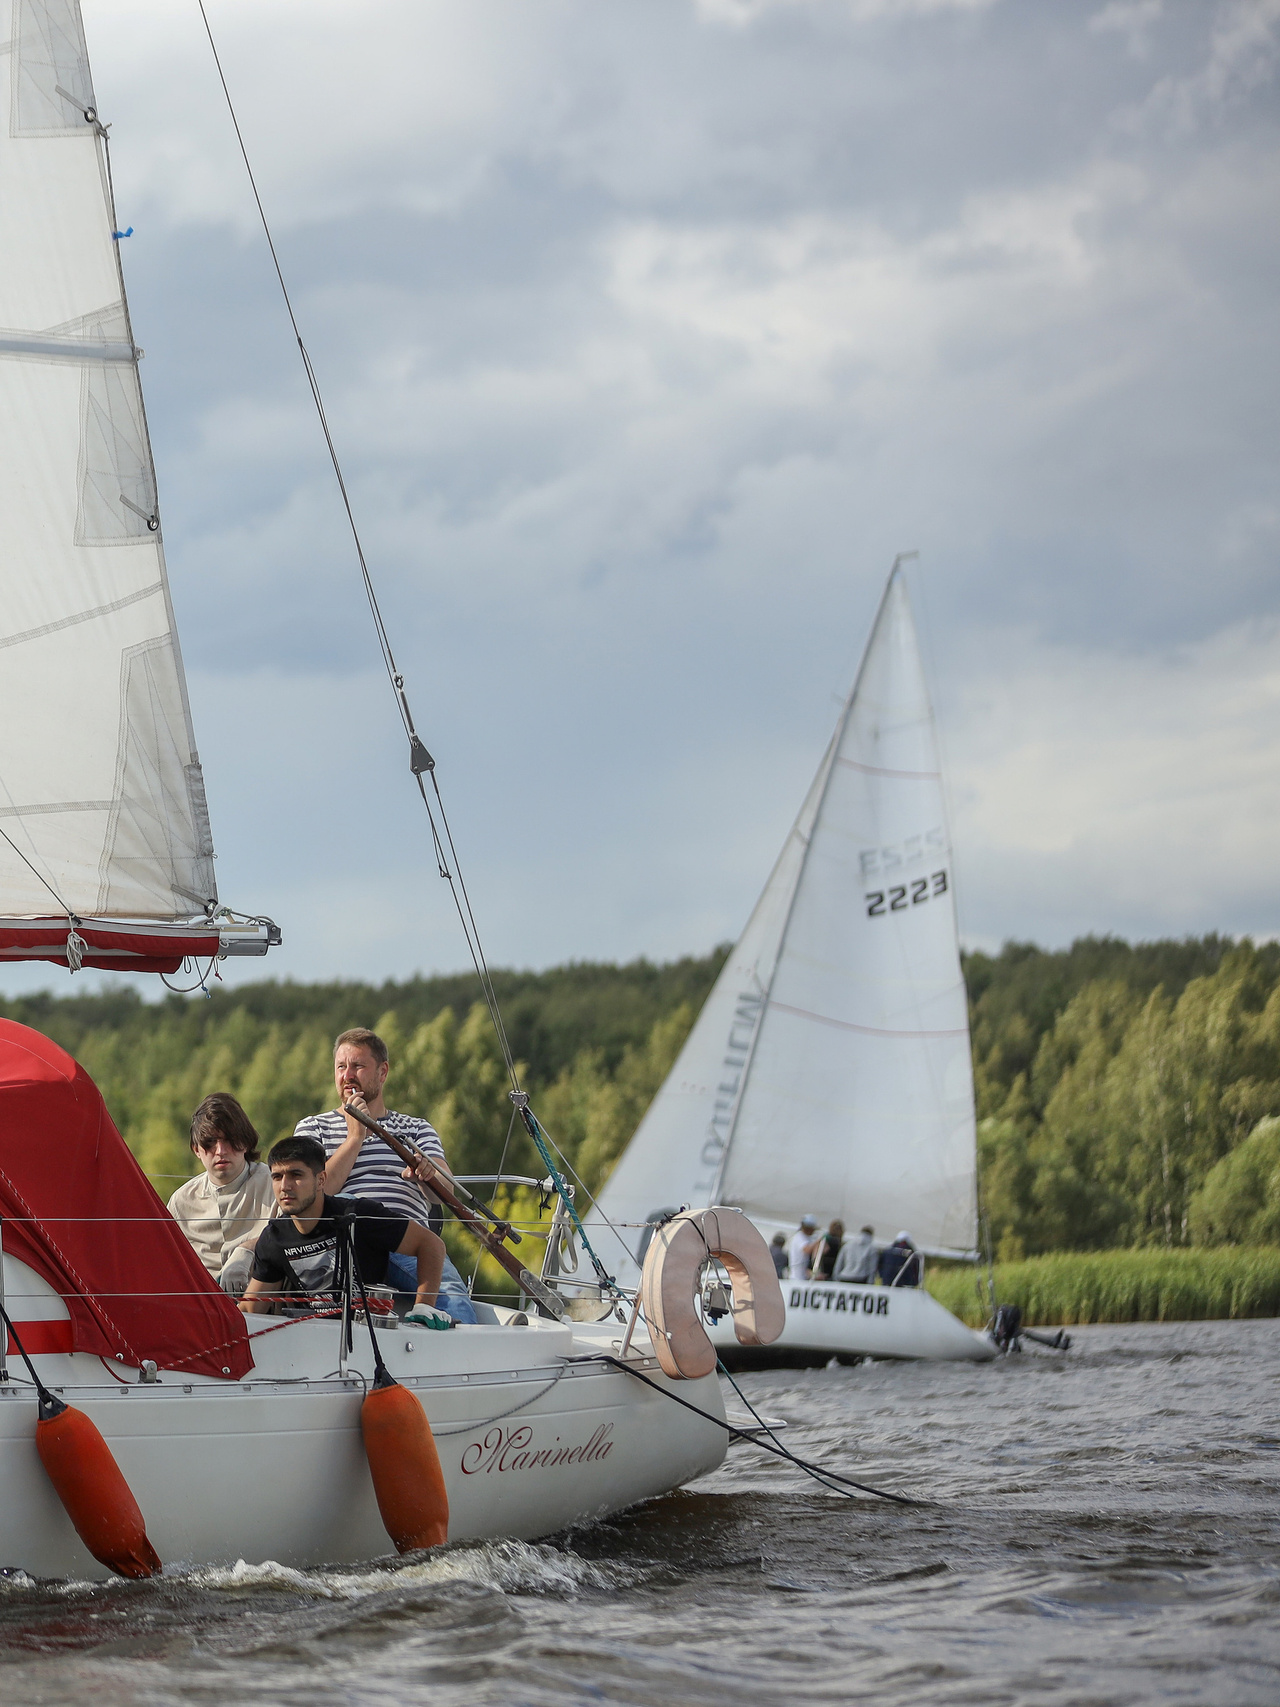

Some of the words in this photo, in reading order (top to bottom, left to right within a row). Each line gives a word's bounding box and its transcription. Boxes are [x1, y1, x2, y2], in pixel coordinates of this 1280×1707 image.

[865, 868, 949, 918] 2223
[790, 1288, 889, 1315] DICTATOR
[461, 1422, 614, 1475] Marinella
